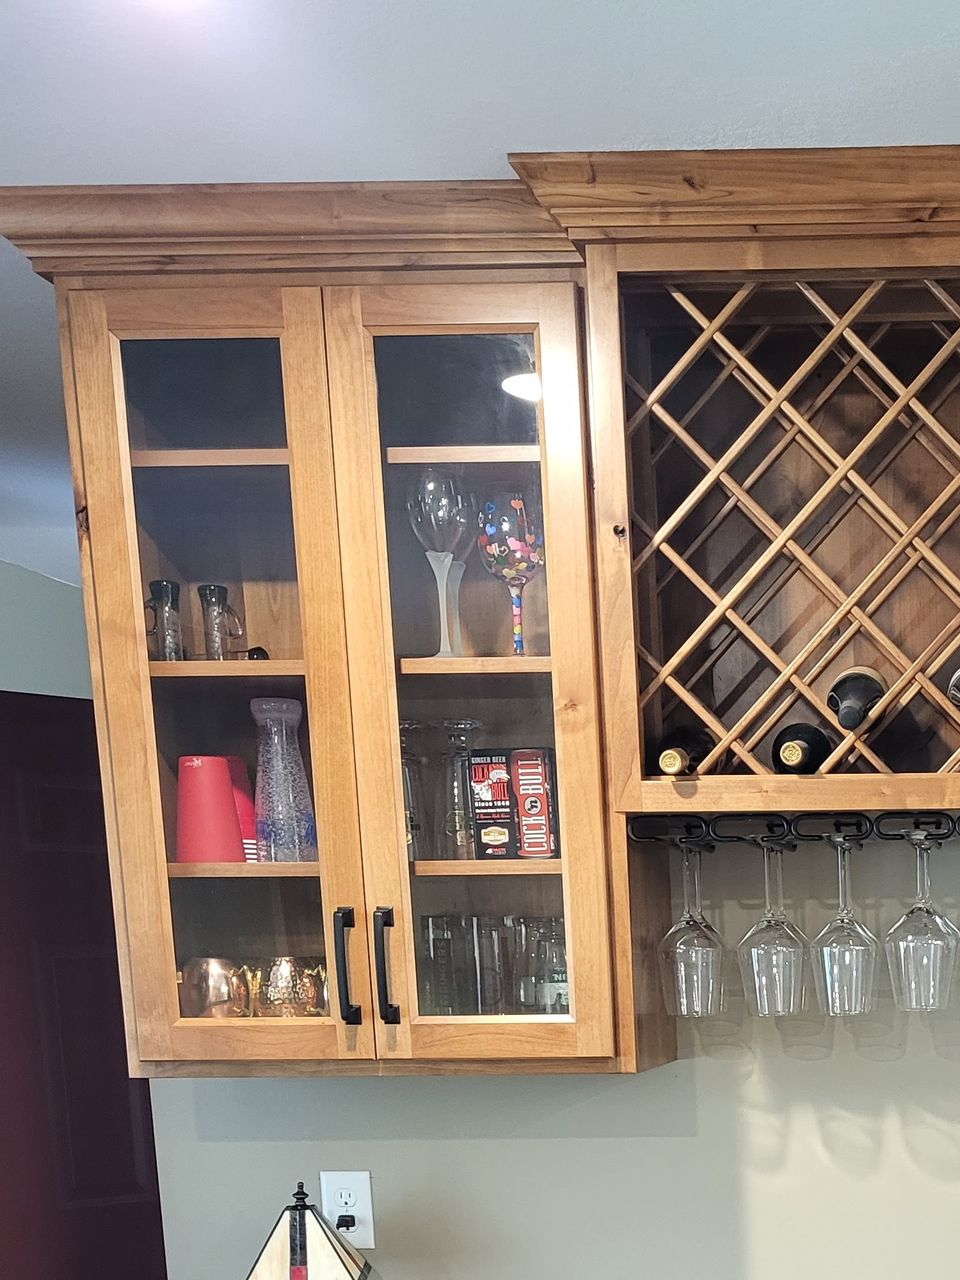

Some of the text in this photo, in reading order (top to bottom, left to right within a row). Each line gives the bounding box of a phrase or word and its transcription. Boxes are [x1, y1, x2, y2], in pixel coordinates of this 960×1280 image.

[491, 783, 509, 800] BULL
[517, 757, 544, 795] BULL
[521, 815, 548, 851] COCK
